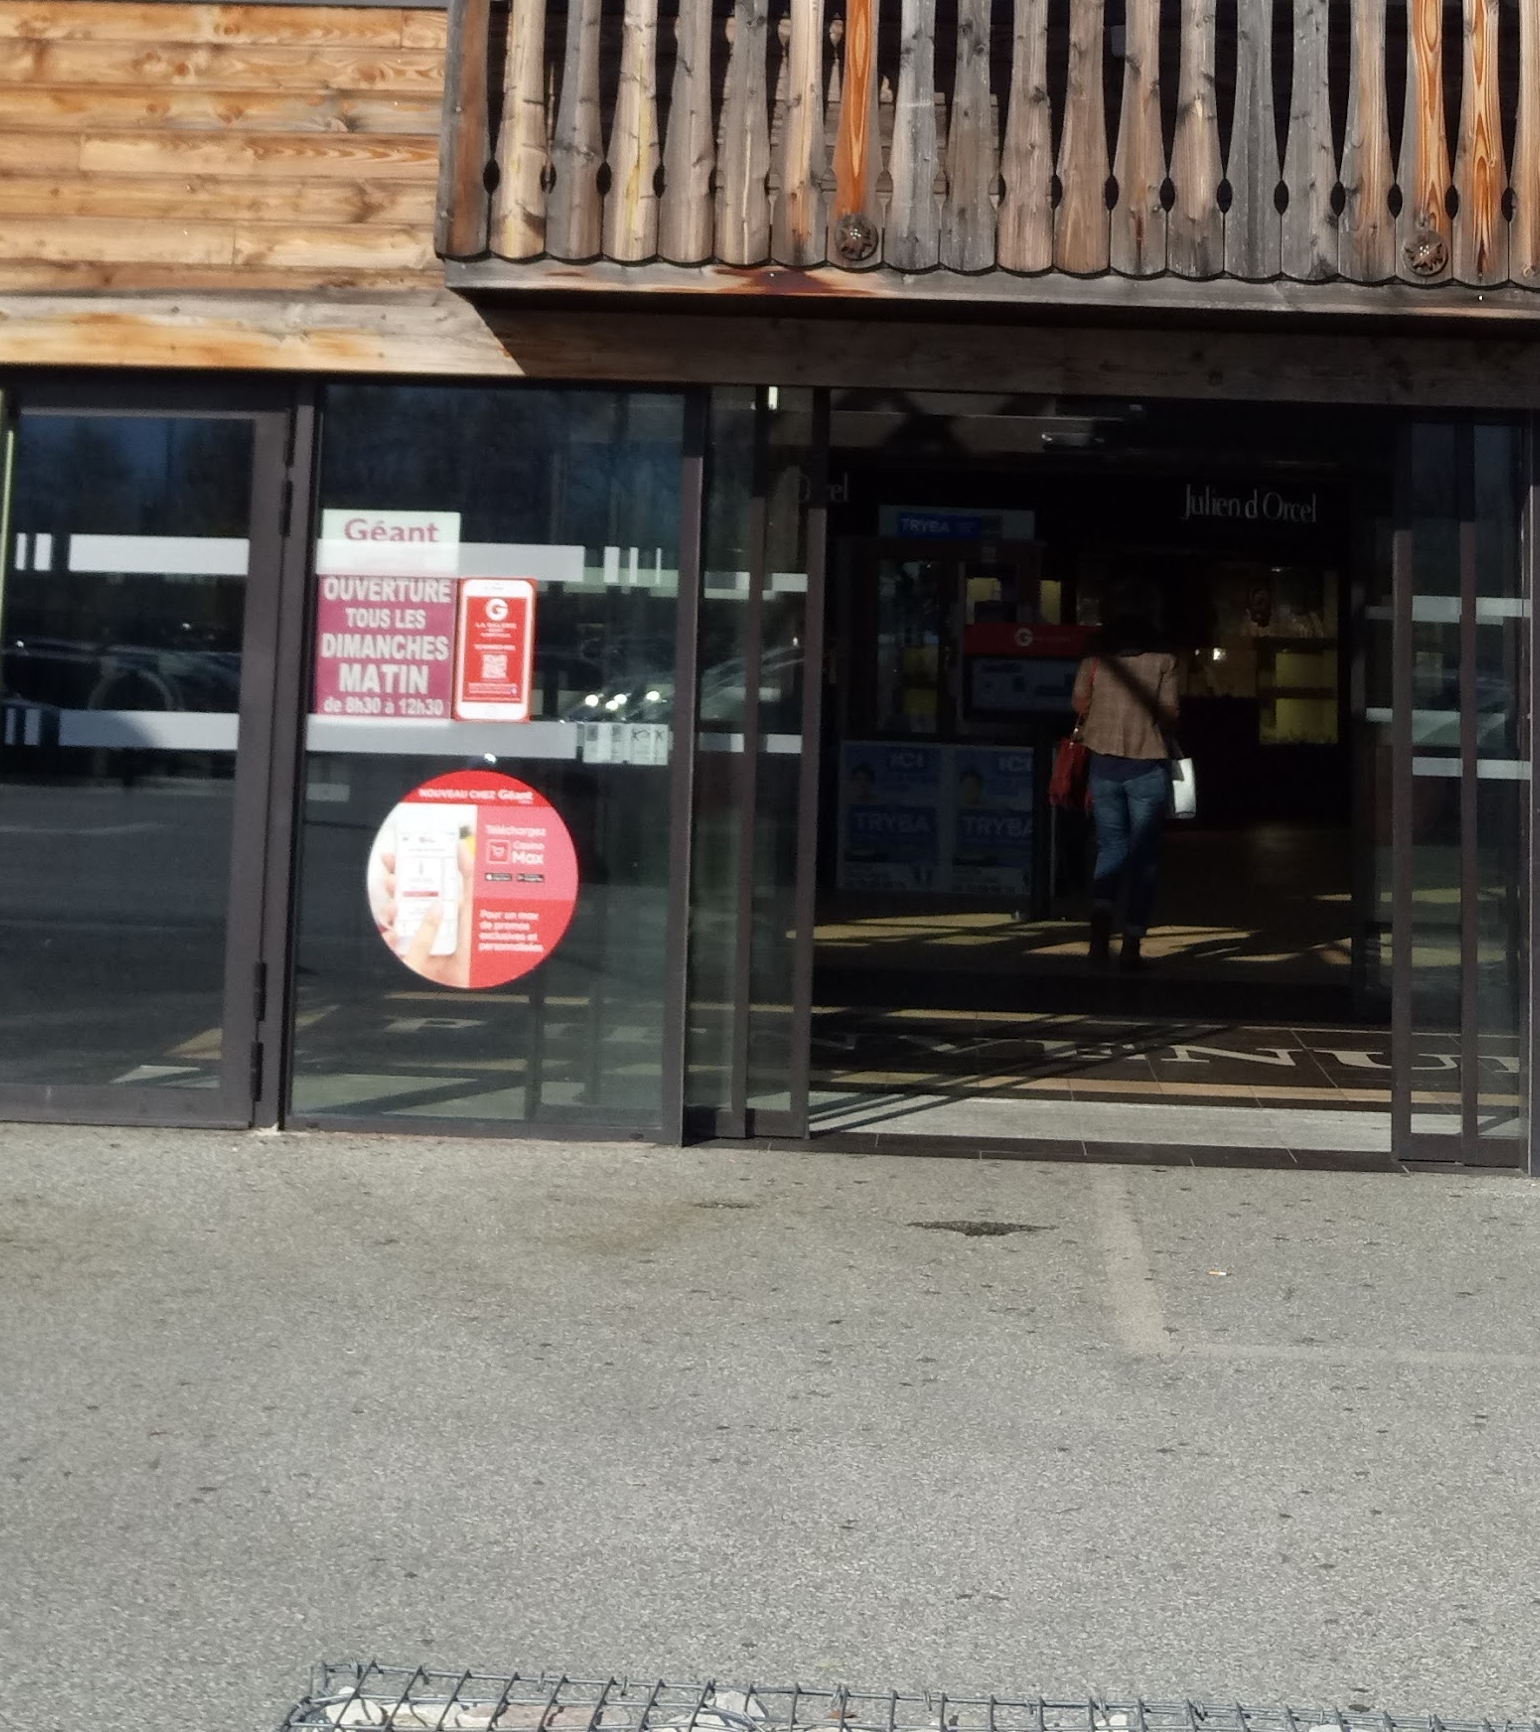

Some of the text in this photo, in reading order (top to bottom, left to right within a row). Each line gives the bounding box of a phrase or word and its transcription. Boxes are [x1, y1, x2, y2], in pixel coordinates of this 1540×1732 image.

[1181, 483, 1242, 520] Julien
[344, 517, 440, 543] Géant
[323, 576, 452, 604] OUVERTURE
[344, 607, 426, 629] TOUS LES
[321, 632, 450, 661] DIMANCHES
[338, 662, 430, 695] MATIN
[323, 697, 341, 713] de
[399, 698, 445, 716] 12h30
[418, 788, 469, 800] NOUVEAU
[498, 788, 534, 802] Géant
[511, 850, 544, 866] Max
